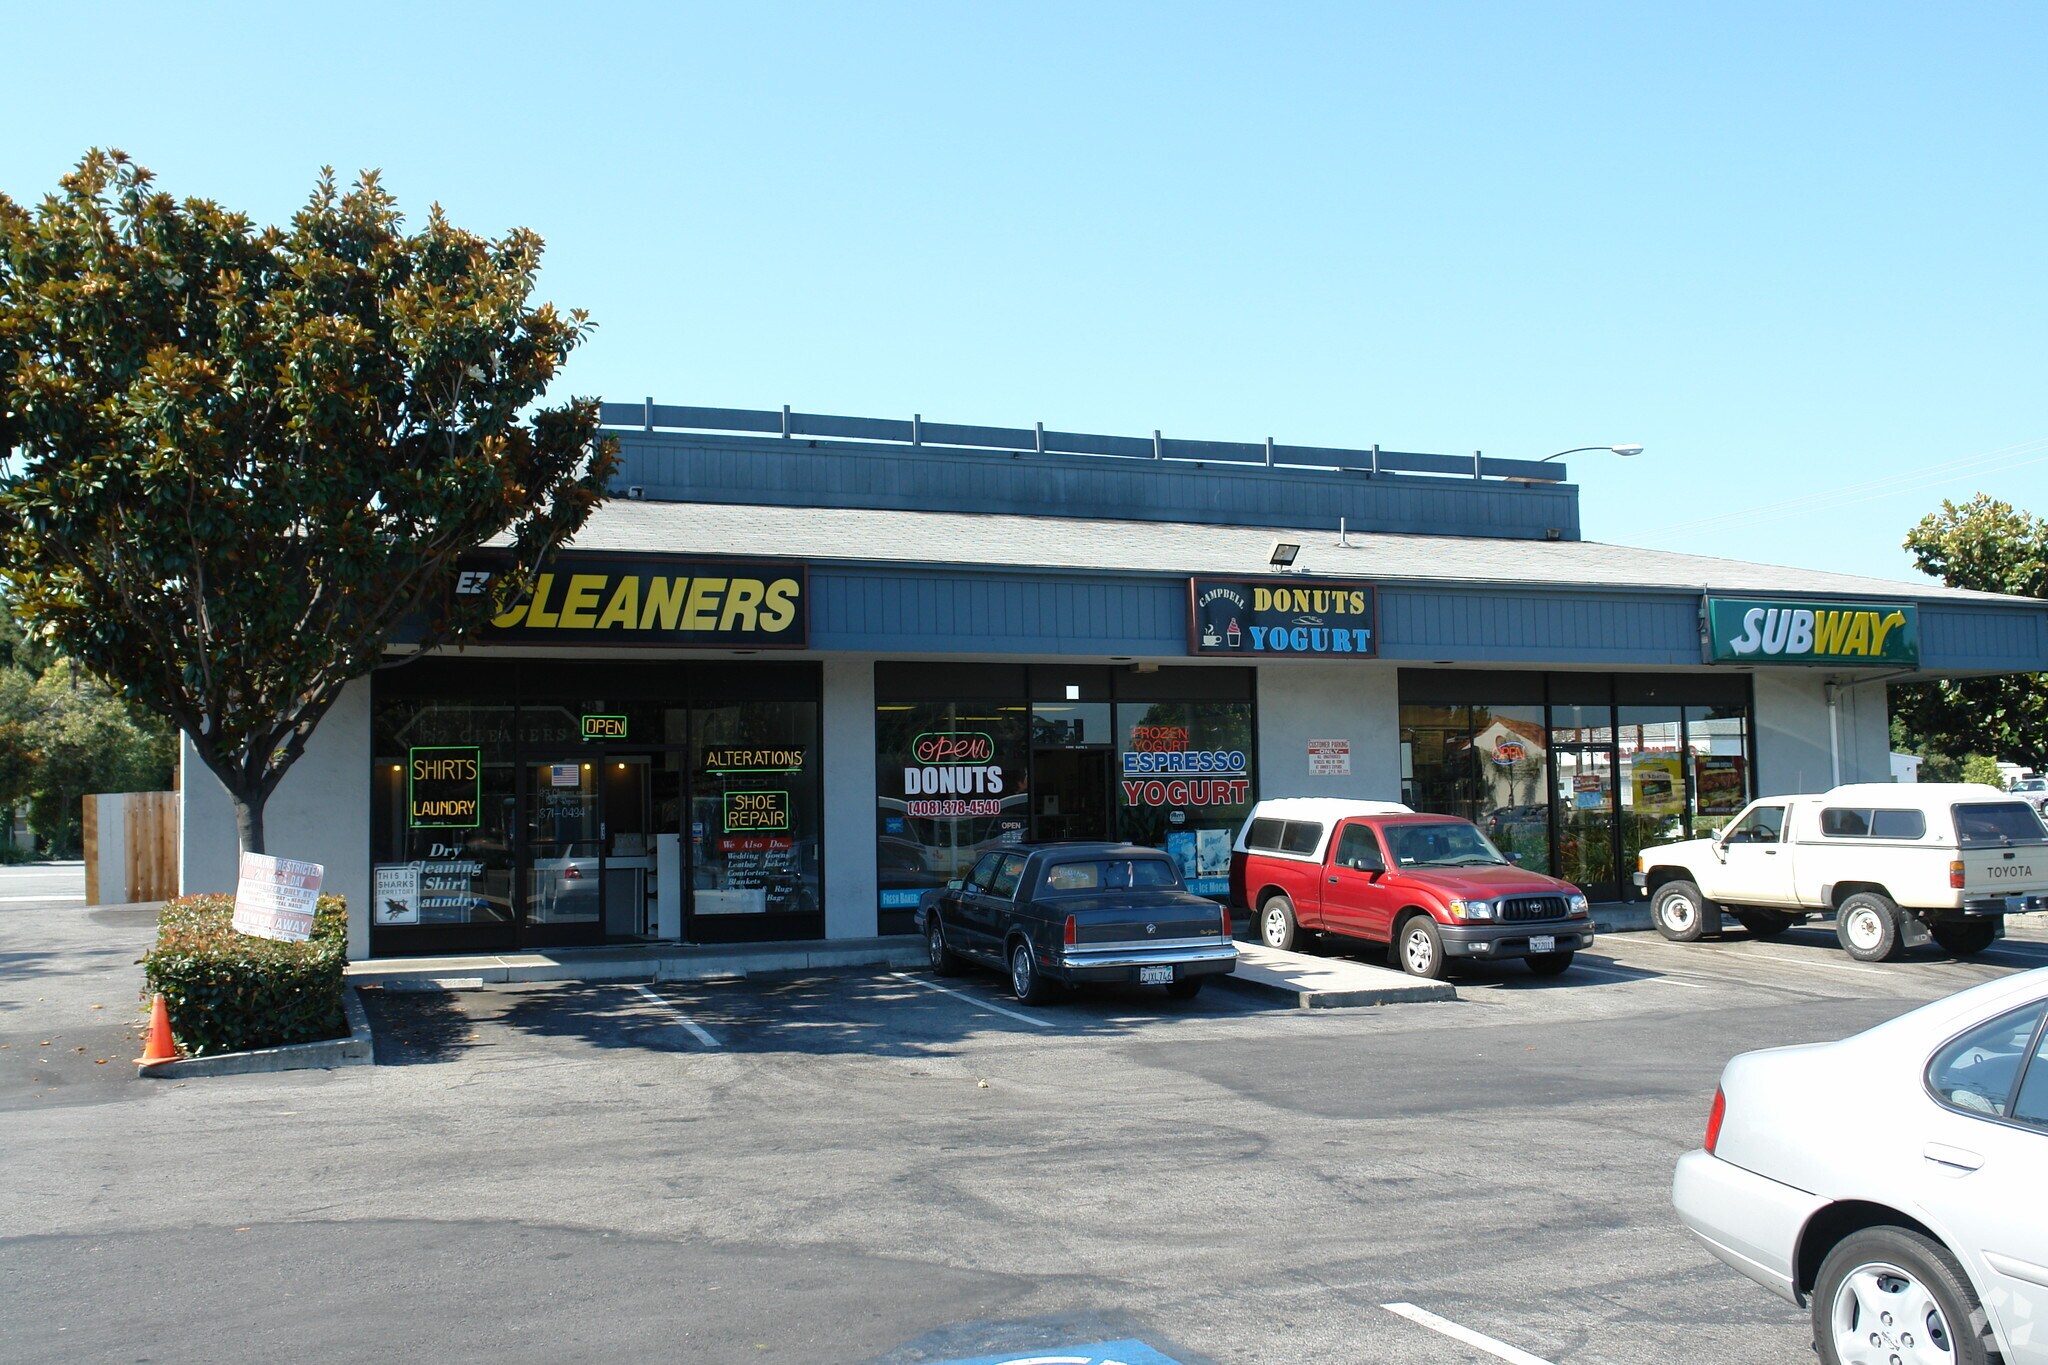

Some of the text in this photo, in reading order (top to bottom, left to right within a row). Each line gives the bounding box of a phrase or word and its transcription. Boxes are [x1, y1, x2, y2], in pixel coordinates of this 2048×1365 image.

[455, 571, 800, 633] EZ CLEANERS
[1199, 588, 1244, 610] CAMPBELL
[1253, 587, 1365, 615] DONUTS
[1249, 626, 1371, 652] YOGURT
[1730, 607, 1906, 656] SUBWAY
[586, 719, 625, 735] OPEN
[1132, 727, 1188, 739] FROZEN
[917, 736, 990, 762] open
[1133, 740, 1189, 752] YOGURT
[1491, 747, 1525, 760] OPEN
[706, 750, 803, 766] ALTERATIONS
[1123, 751, 1246, 772] ESPRESSO
[413, 759, 477, 780] SHIRTS
[904, 766, 1003, 795] DONUTS
[1122, 780, 1249, 806] YOGURT
[413, 800, 476, 817] LAUNDRY
[734, 795, 776, 810] SHOE
[908, 799, 1001, 816] (408) 378-4540
[728, 811, 785, 826] REPAIR
[1001, 822, 1021, 830] OPEN
[429, 843, 463, 860] Dry
[723, 840, 735, 849] We
[742, 840, 763, 849] Also
[727, 852, 789, 860] Wedding Gowns
[277, 859, 321, 877] RESTRICTED
[408, 860, 484, 876] Cleaning
[727, 869, 769, 877] Comforters
[763, 861, 789, 869] Jackets
[1987, 866, 2032, 878] TOYOTA
[290, 875, 306, 887] DAY
[378, 880, 414, 888] SHARKS
[424, 877, 467, 890] Shirt
[774, 885, 792, 893] Rugs
[416, 893, 482, 911] aundry
[766, 894, 784, 902] Bags
[275, 918, 308, 932] AWAY
